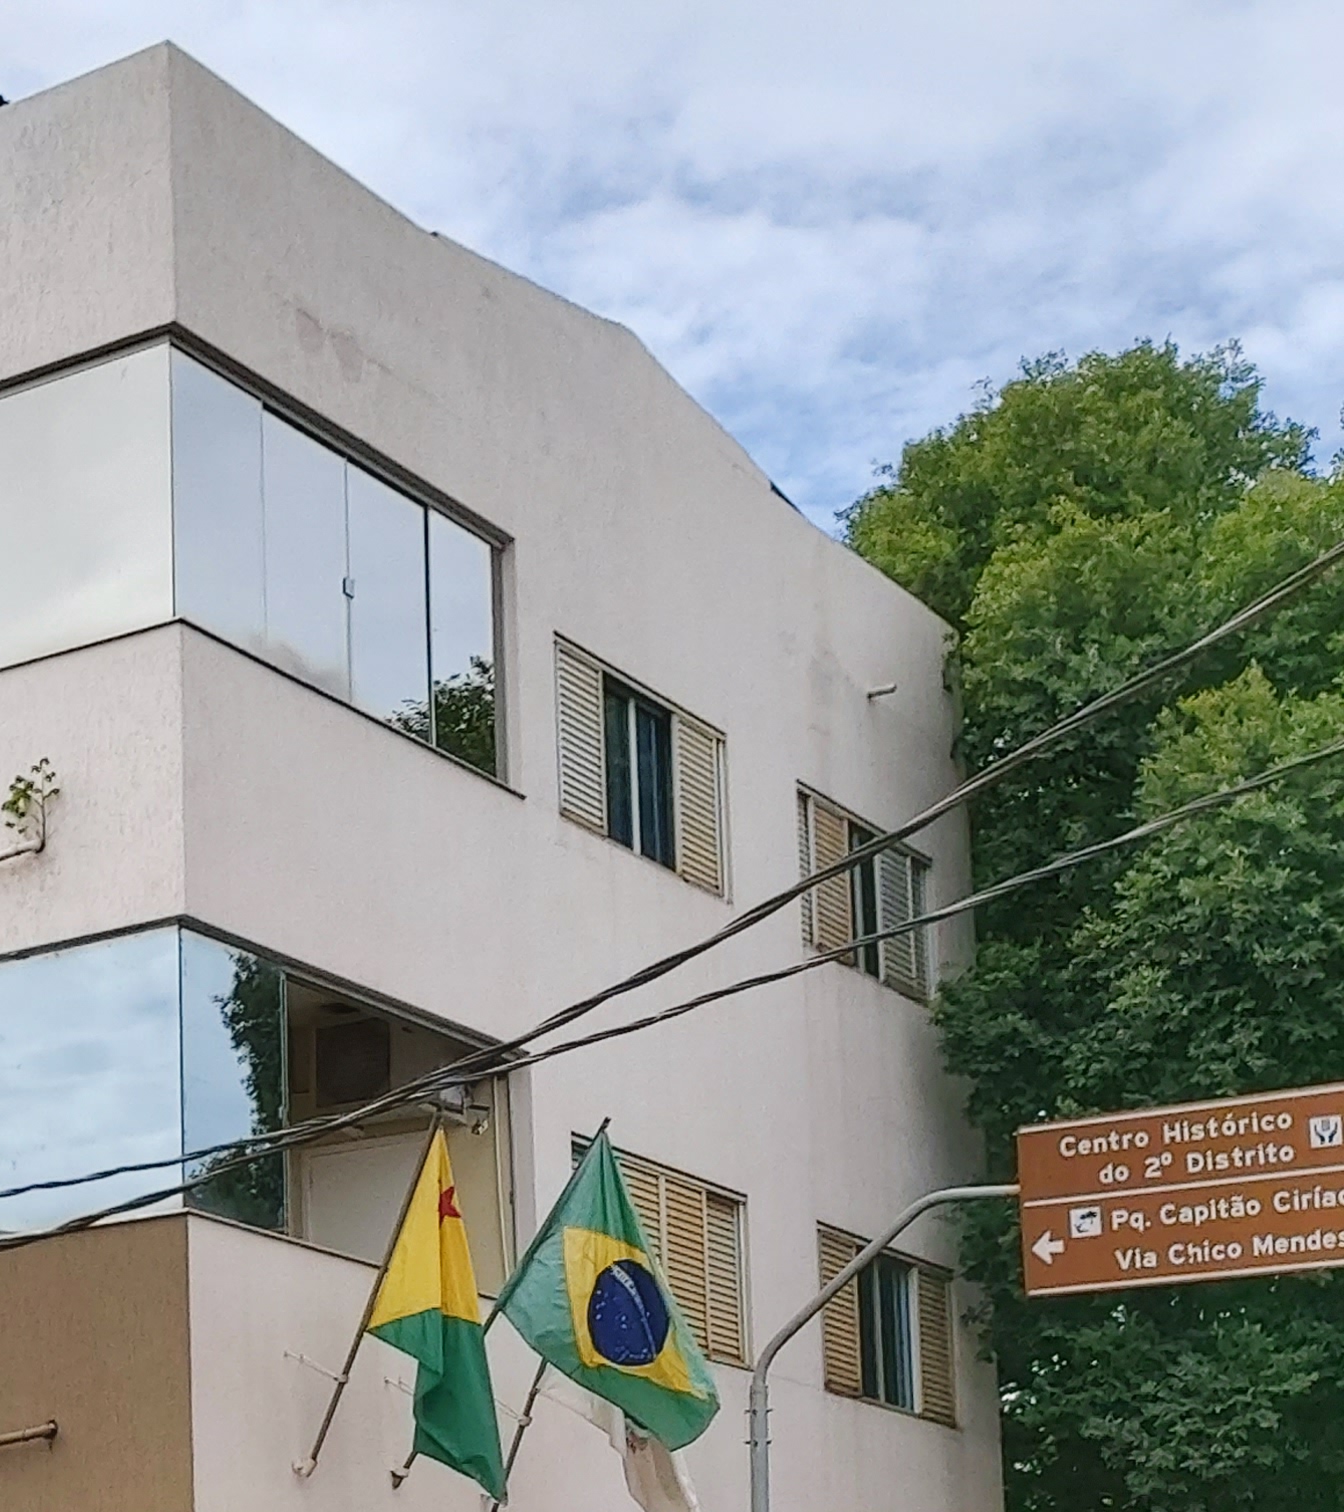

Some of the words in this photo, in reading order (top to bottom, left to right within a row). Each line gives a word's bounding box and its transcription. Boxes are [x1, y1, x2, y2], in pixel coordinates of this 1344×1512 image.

[1059, 1131, 1149, 1157] Centro
[1162, 1112, 1292, 1144] Histórico
[1099, 1164, 1129, 1184] do
[1186, 1144, 1294, 1173] Distrito
[1111, 1209, 1152, 1231] Pq.
[1159, 1194, 1261, 1226] Capitão
[1115, 1248, 1158, 1270] Via
[1168, 1240, 1242, 1265] Chico
